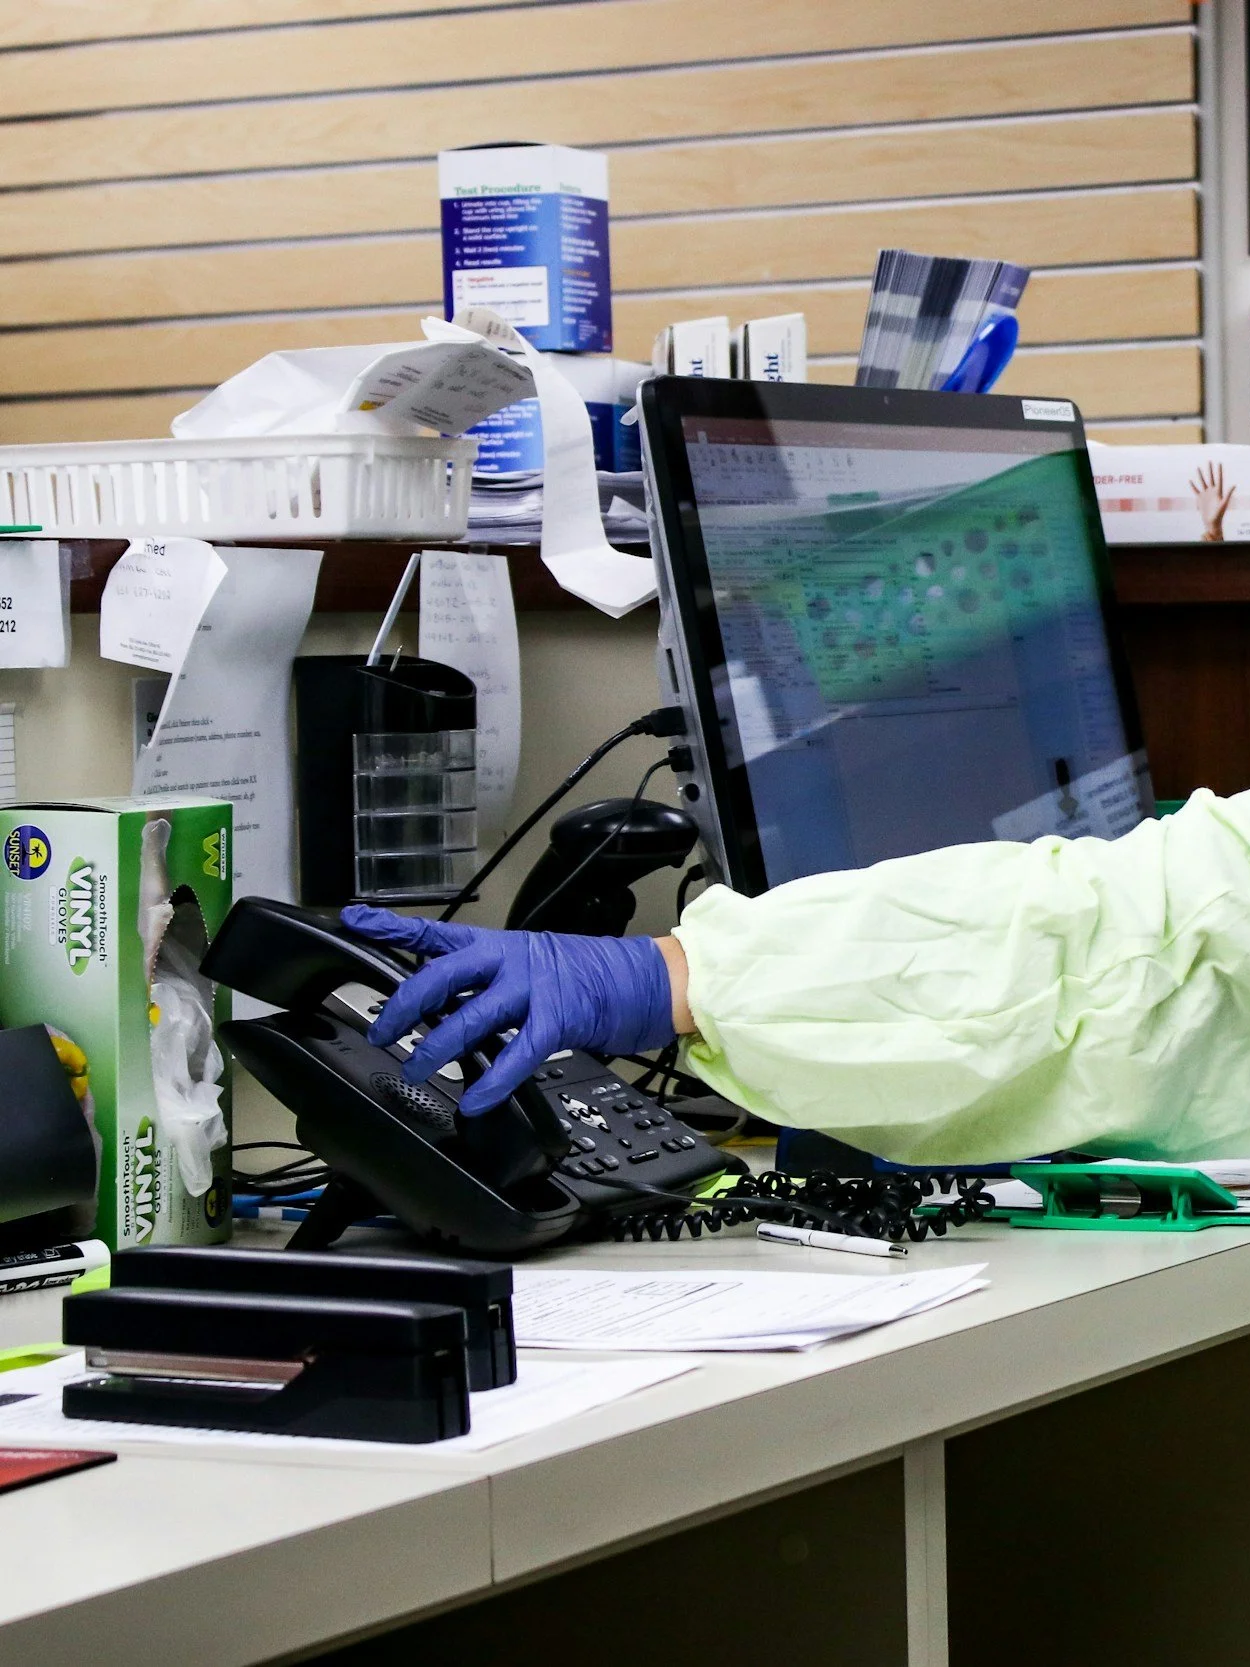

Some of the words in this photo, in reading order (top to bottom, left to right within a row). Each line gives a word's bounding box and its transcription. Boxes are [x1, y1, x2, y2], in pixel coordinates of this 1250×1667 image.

[454, 186, 478, 196] Test
[481, 183, 541, 194] Procedure
[1093, 474, 1145, 485] DER-FREE
[0, 597, 13, 610] 52
[0, 620, 16, 634] 212
[9, 831, 20, 875] SUNSET
[59, 888, 67, 944] GLOVES
[70, 866, 92, 966] VINYL
[99, 874, 108, 963] SmoothTouch
[135, 1126, 153, 1243] VINYL
